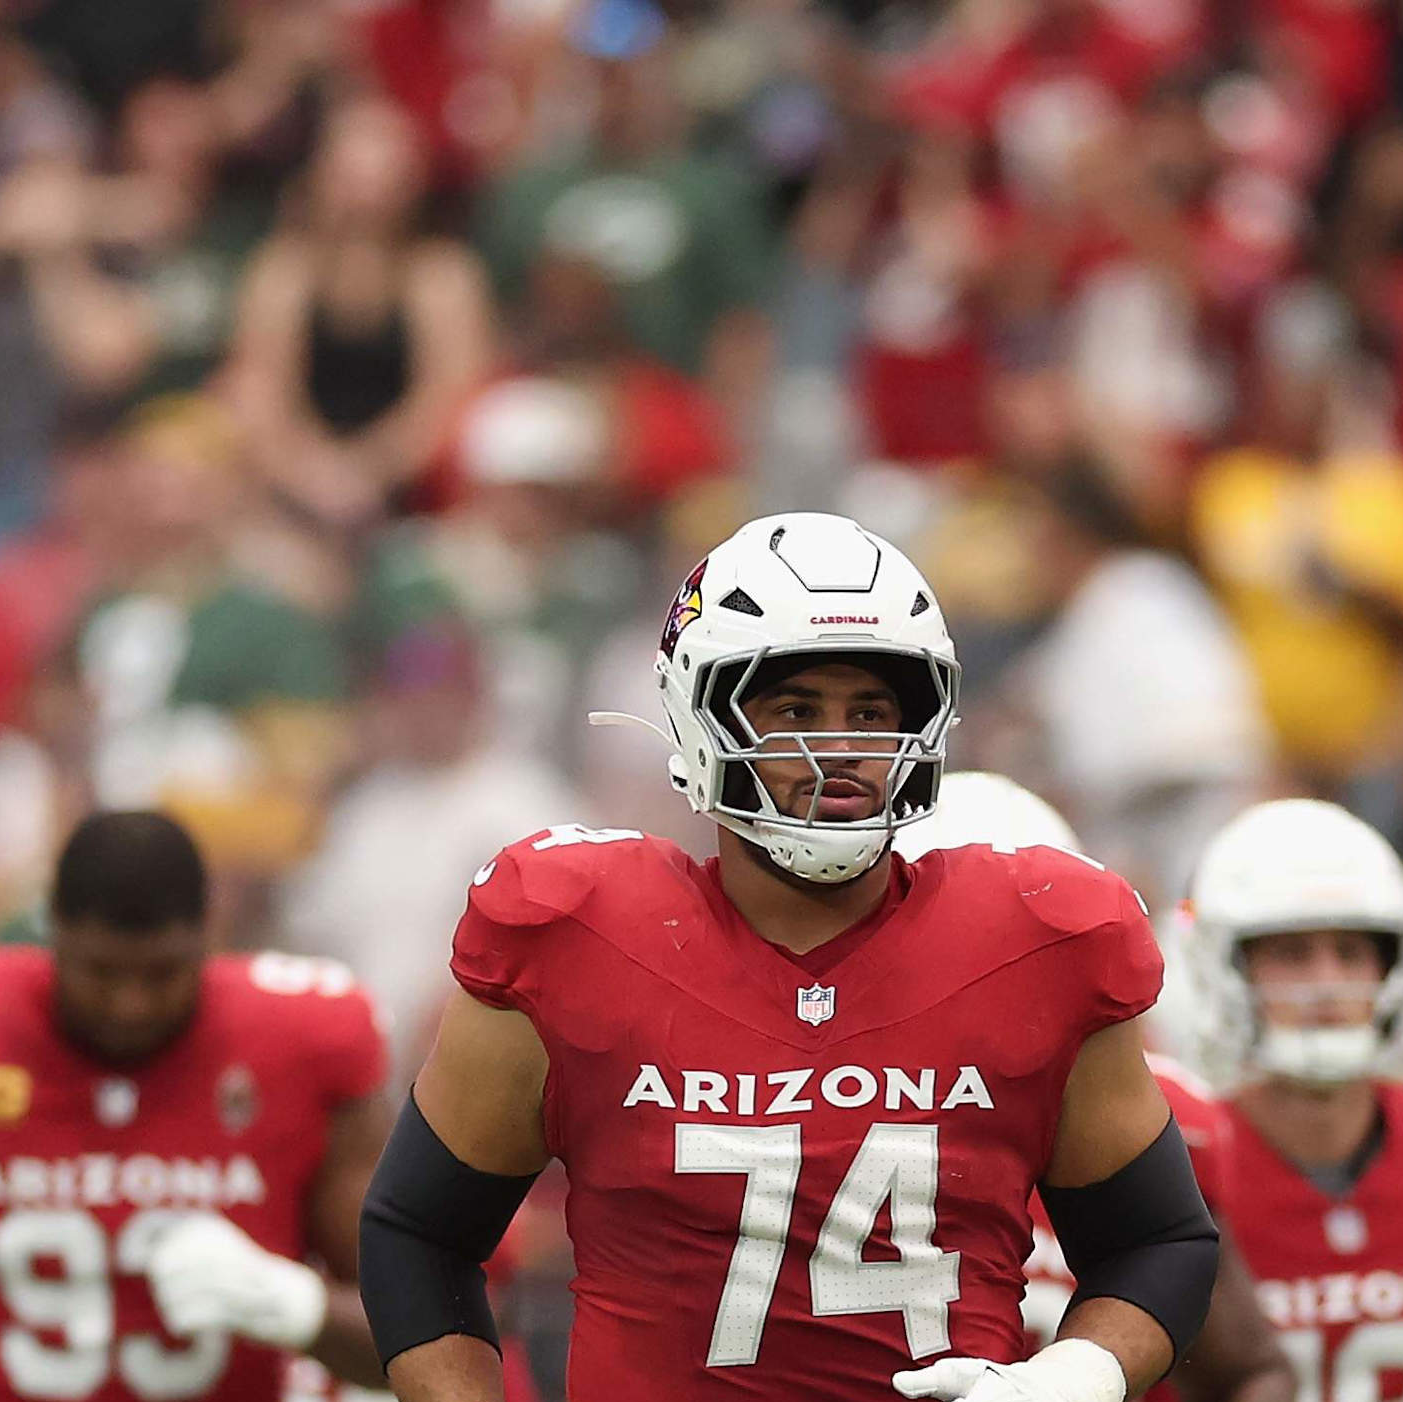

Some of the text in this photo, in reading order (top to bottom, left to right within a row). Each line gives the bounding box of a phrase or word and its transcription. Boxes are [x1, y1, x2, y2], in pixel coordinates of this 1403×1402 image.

[810, 615, 879, 625] CARDINALS
[623, 1064, 995, 1116] ARIZONA
[674, 1122, 961, 1368] 74
